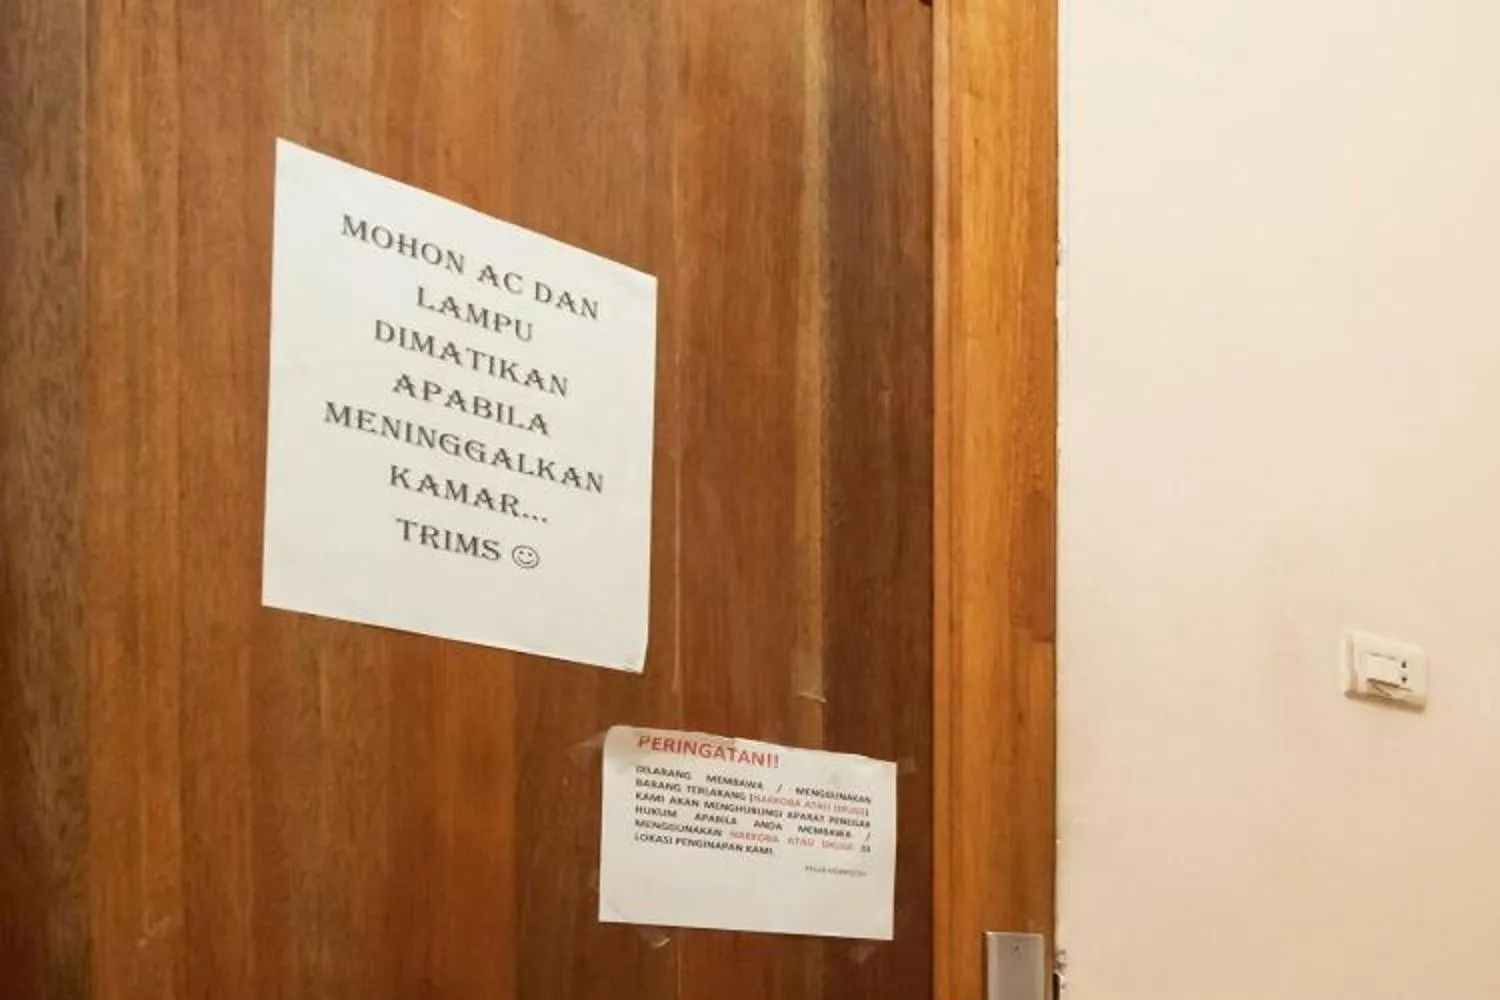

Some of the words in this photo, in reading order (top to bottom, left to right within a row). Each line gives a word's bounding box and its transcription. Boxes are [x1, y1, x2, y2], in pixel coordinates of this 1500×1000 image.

[340, 214, 465, 274] MOHON
[476, 263, 524, 295] AC
[534, 283, 600, 321] DAN
[416, 286, 534, 343] LAMPU
[373, 319, 569, 398] DIMATIKAN
[392, 373, 550, 437] APABILA
[324, 401, 604, 494] MENINGGALKAN
[389, 464, 549, 524] KAMAR...
[395, 517, 502, 563] TRIMS
[635, 778, 682, 793] BARANG
[686, 785, 747, 801] TERLARANG
[635, 792, 665, 804] KAMI
[669, 796, 700, 808] AKAN
[703, 800, 783, 819] MENGHUBUNGI
[787, 811, 825, 823] APARAT
[636, 766, 692, 781] DILARANG
[706, 774, 764, 790] MEMBAWA
[795, 787, 871, 804] MENGGUNAKAN
[635, 805, 677, 818] HUKUM
[694, 813, 737, 825] APABILA
[753, 819, 783, 831] ANDA
[635, 819, 723, 837] MENGGUNAKAN
[634, 831, 673, 845] LOKASI
[675, 837, 744, 852] PENGINAPAN
